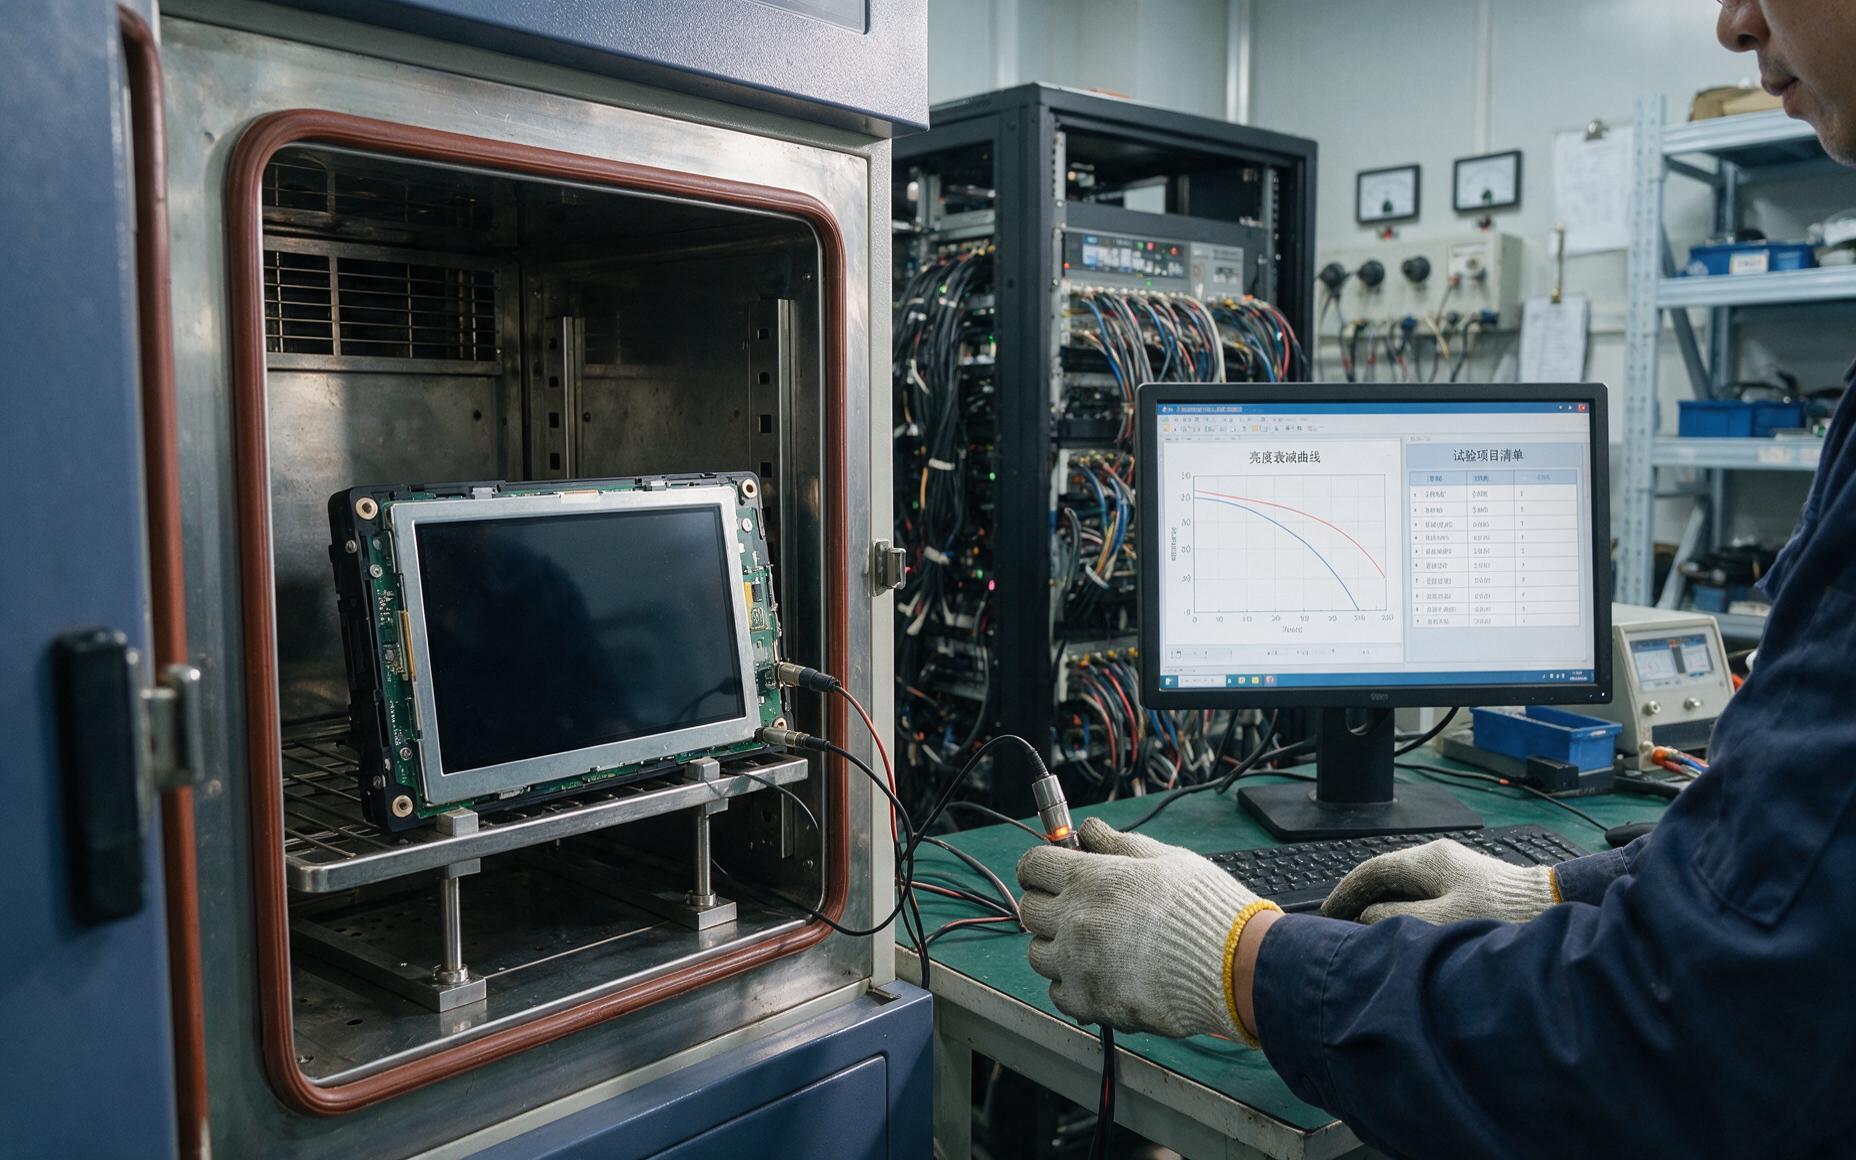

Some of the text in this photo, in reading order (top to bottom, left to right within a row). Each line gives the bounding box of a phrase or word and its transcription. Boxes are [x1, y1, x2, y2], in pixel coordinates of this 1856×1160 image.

[1453, 448, 1524, 462] 试验项目清单
